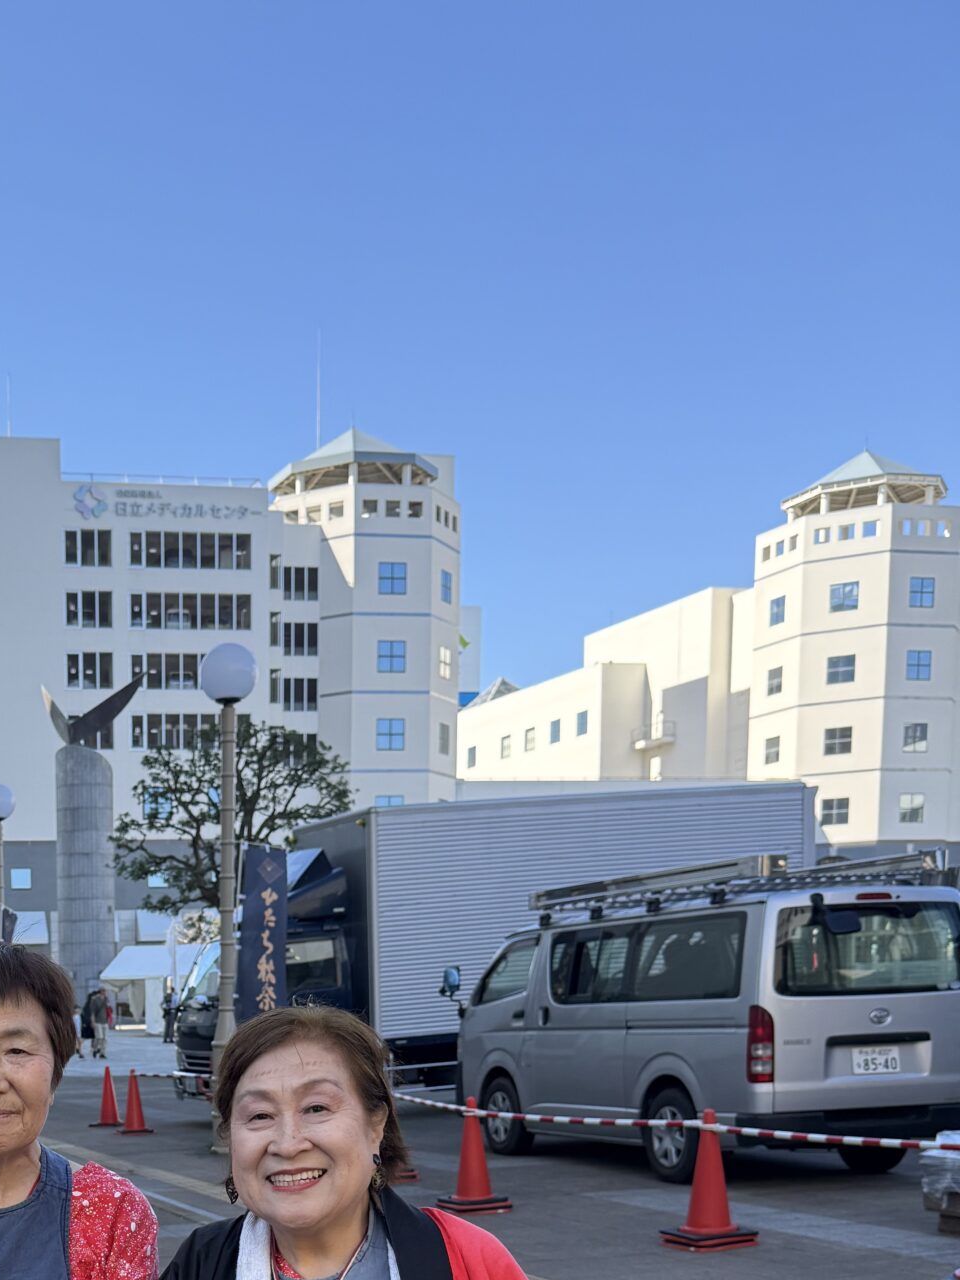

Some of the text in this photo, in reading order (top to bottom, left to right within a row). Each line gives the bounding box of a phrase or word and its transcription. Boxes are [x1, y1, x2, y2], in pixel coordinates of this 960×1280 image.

[115, 501, 262, 520] 日立メディカルセンター
[863, 1056, 897, 1070] 85-40
